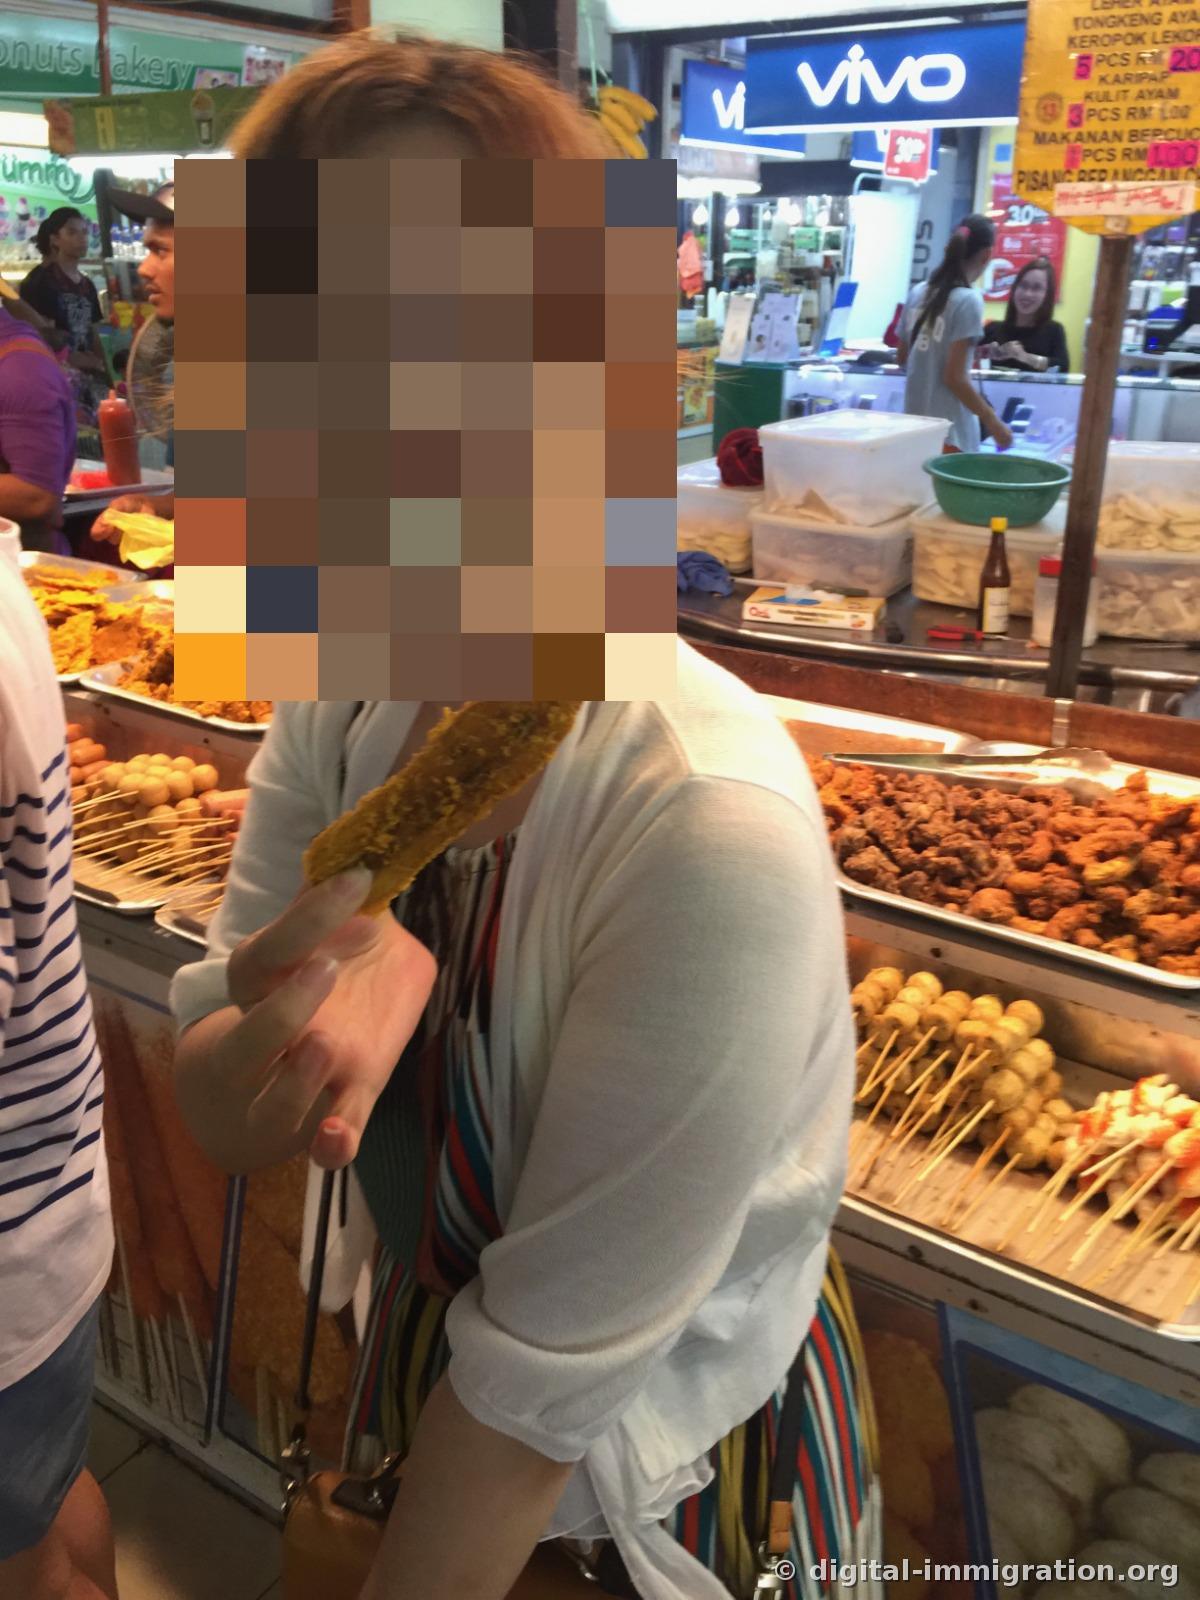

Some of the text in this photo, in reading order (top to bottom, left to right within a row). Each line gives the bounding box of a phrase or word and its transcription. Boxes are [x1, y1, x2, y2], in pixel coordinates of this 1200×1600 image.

[1073, 10, 1200, 30] TONGKENG AYA
[1067, 32, 1147, 49] KEROPOK
[0, 38, 83, 76] nuts
[91, 40, 196, 92] akery
[1095, 52, 1131, 68] PCS
[796, 43, 967, 107] vivo
[1098, 71, 1170, 85] KARIPAP
[1084, 87, 1180, 102] KULIT AYAM
[712, 81, 745, 130] vi
[1086, 106, 1122, 121] PCS
[1034, 128, 1200, 145] MAKANAN BERCUC
[1082, 148, 1117, 162] PCS
